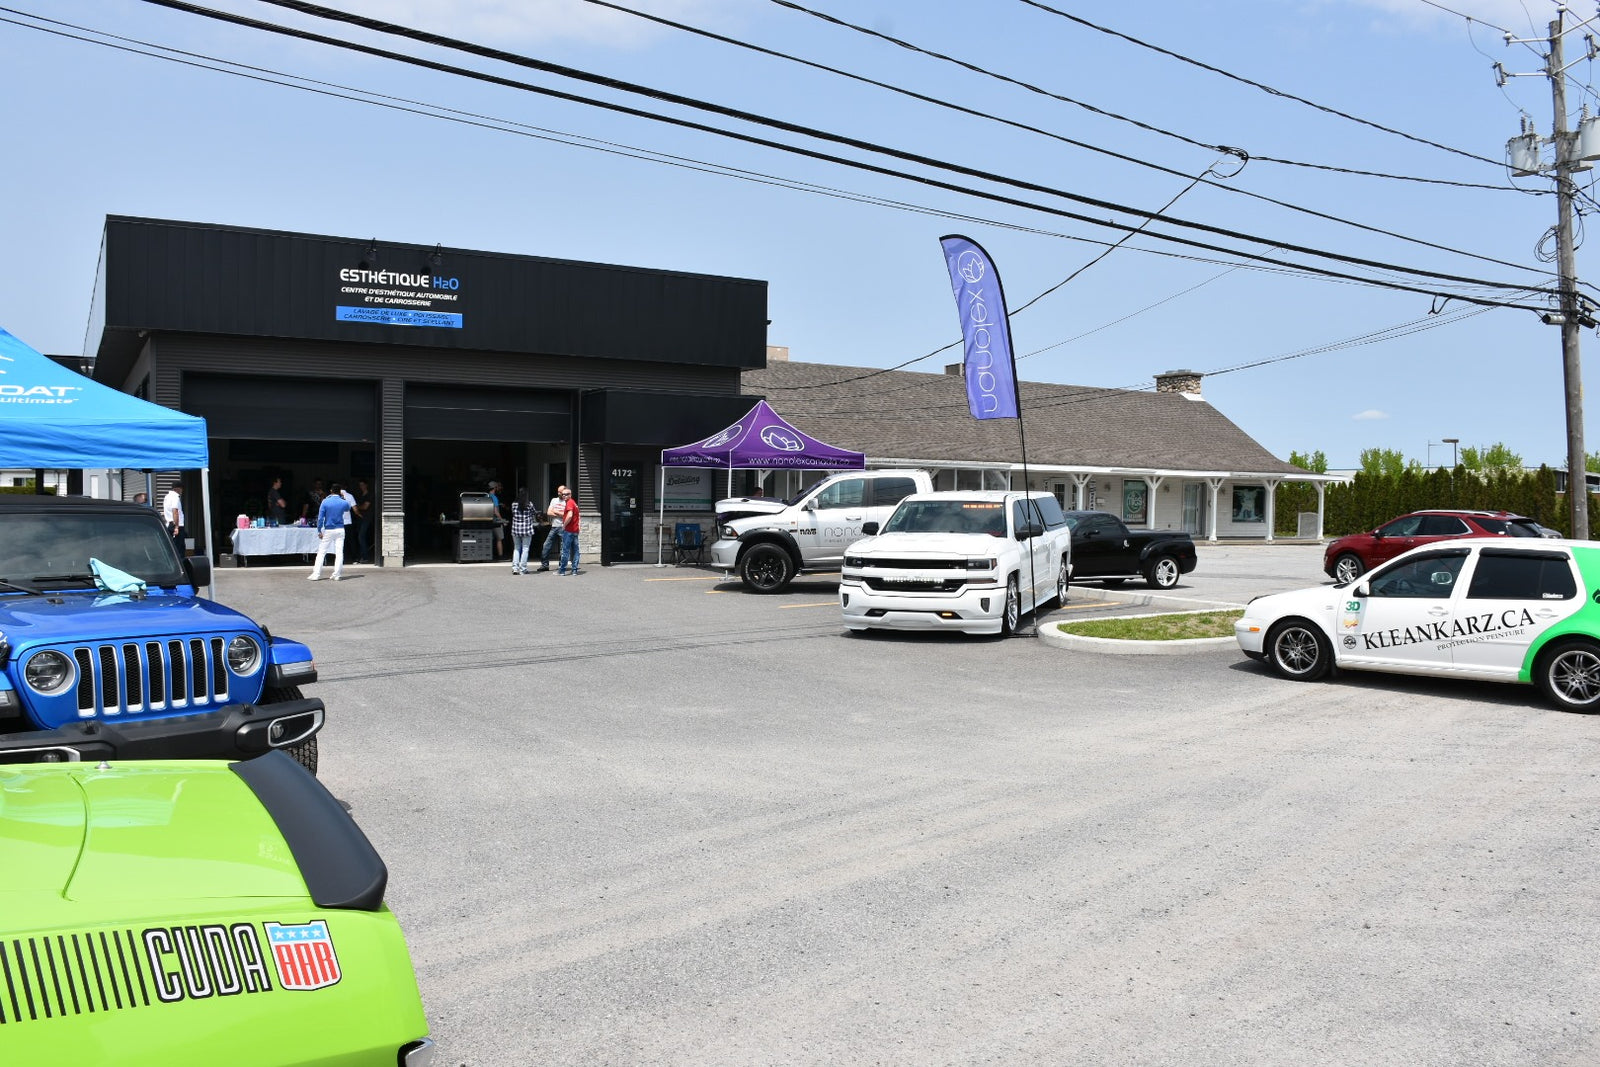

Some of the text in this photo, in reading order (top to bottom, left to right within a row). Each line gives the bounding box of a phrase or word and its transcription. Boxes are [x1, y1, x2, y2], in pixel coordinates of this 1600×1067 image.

[340, 268, 459, 290] ESTHÉTIQUE H2O
[368, 288, 415, 298] D'ESTHÉTIQUE
[416, 292, 458, 301] AUTOMOBILE
[385, 298, 431, 307] CARROSSERIE
[967, 288, 998, 413] nanolex
[612, 469, 632, 477] 4172
[1346, 601, 1360, 611] 3D
[1362, 608, 1535, 650] KLEANKARZ.CA
[1437, 628, 1525, 650] PROTECTION PEINTURE
[142, 923, 272, 1003] CUDA
